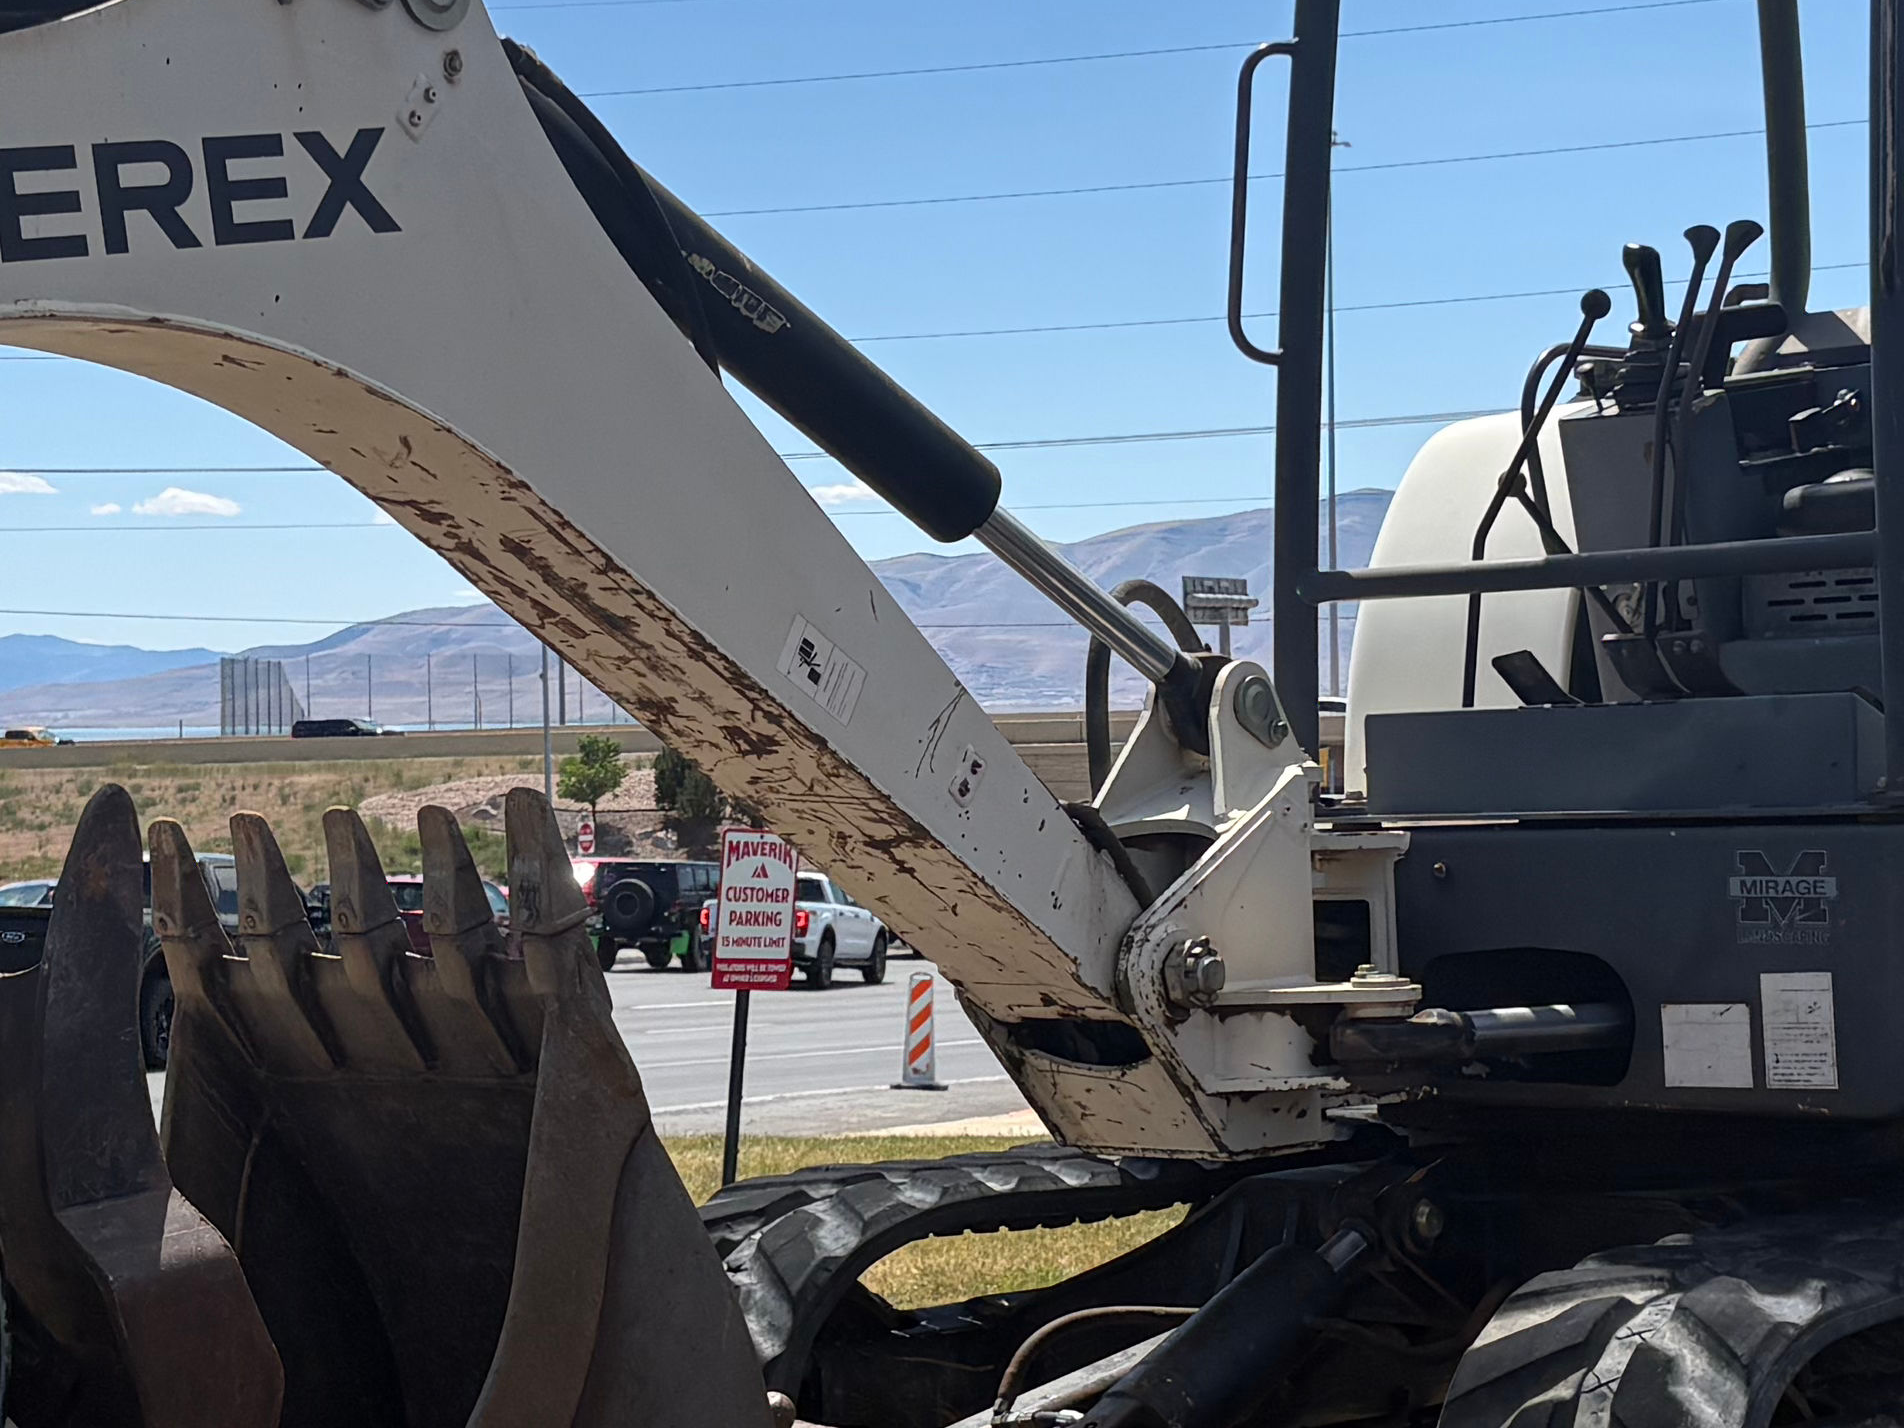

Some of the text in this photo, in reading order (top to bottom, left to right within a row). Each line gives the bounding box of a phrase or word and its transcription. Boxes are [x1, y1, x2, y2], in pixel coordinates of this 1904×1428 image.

[726, 840, 793, 874] MAVERIK
[725, 886, 789, 903] CUSTOMER
[1739, 879, 1827, 895] MIRAGE
[729, 911, 782, 927] PARKING
[721, 935, 786, 948] 15 MINUTE LIMIT
